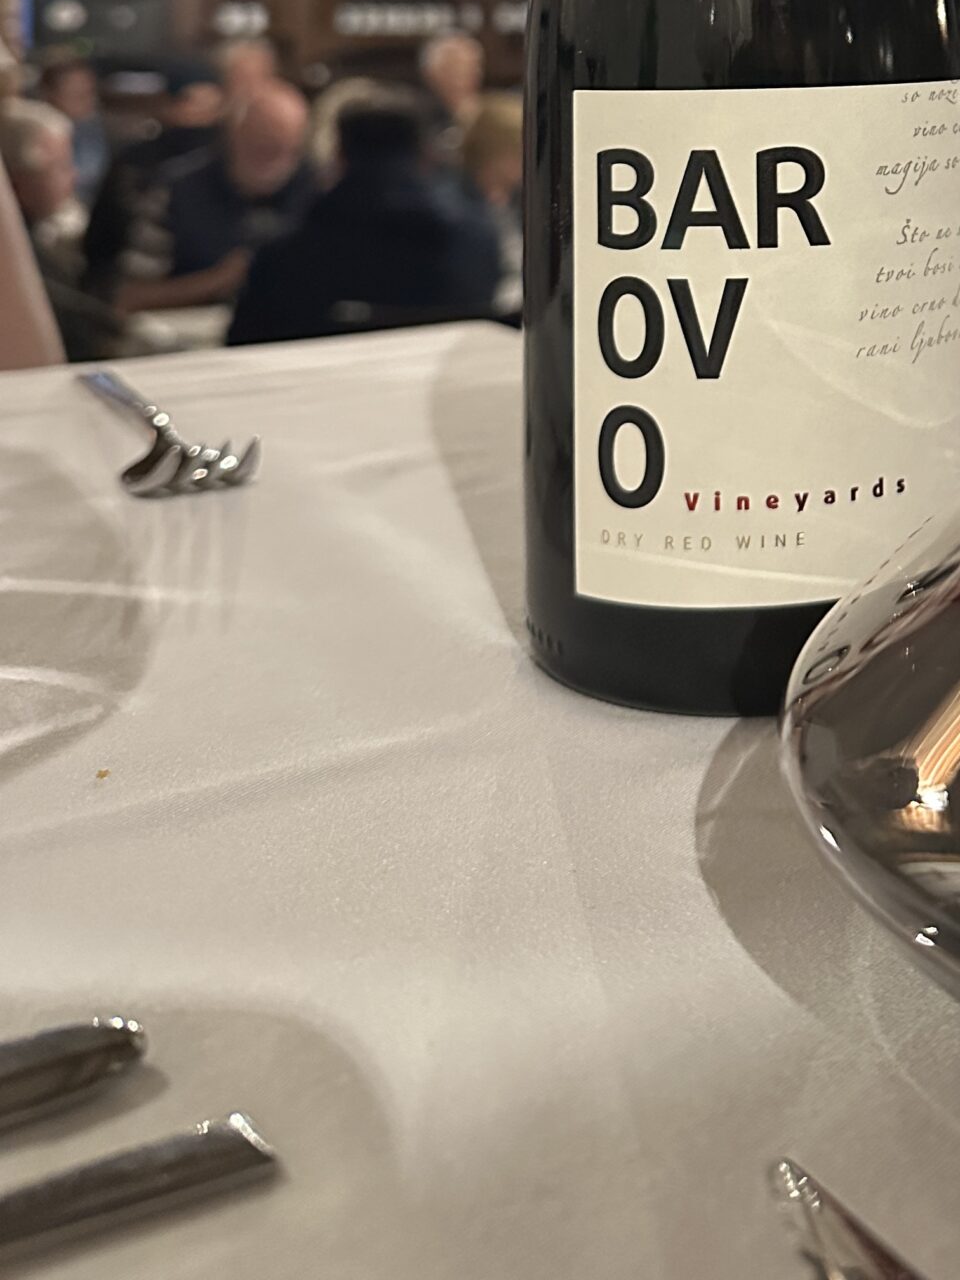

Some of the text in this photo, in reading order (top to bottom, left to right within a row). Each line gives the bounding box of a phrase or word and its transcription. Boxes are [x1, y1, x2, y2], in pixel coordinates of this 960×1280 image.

[597, 146, 831, 250] BAR
[597, 276, 749, 380] OV
[858, 303, 904, 322] vino
[855, 336, 901, 359] rani
[597, 404, 905, 512] O Vineyards
[601, 528, 806, 551] DRY RED WINE
